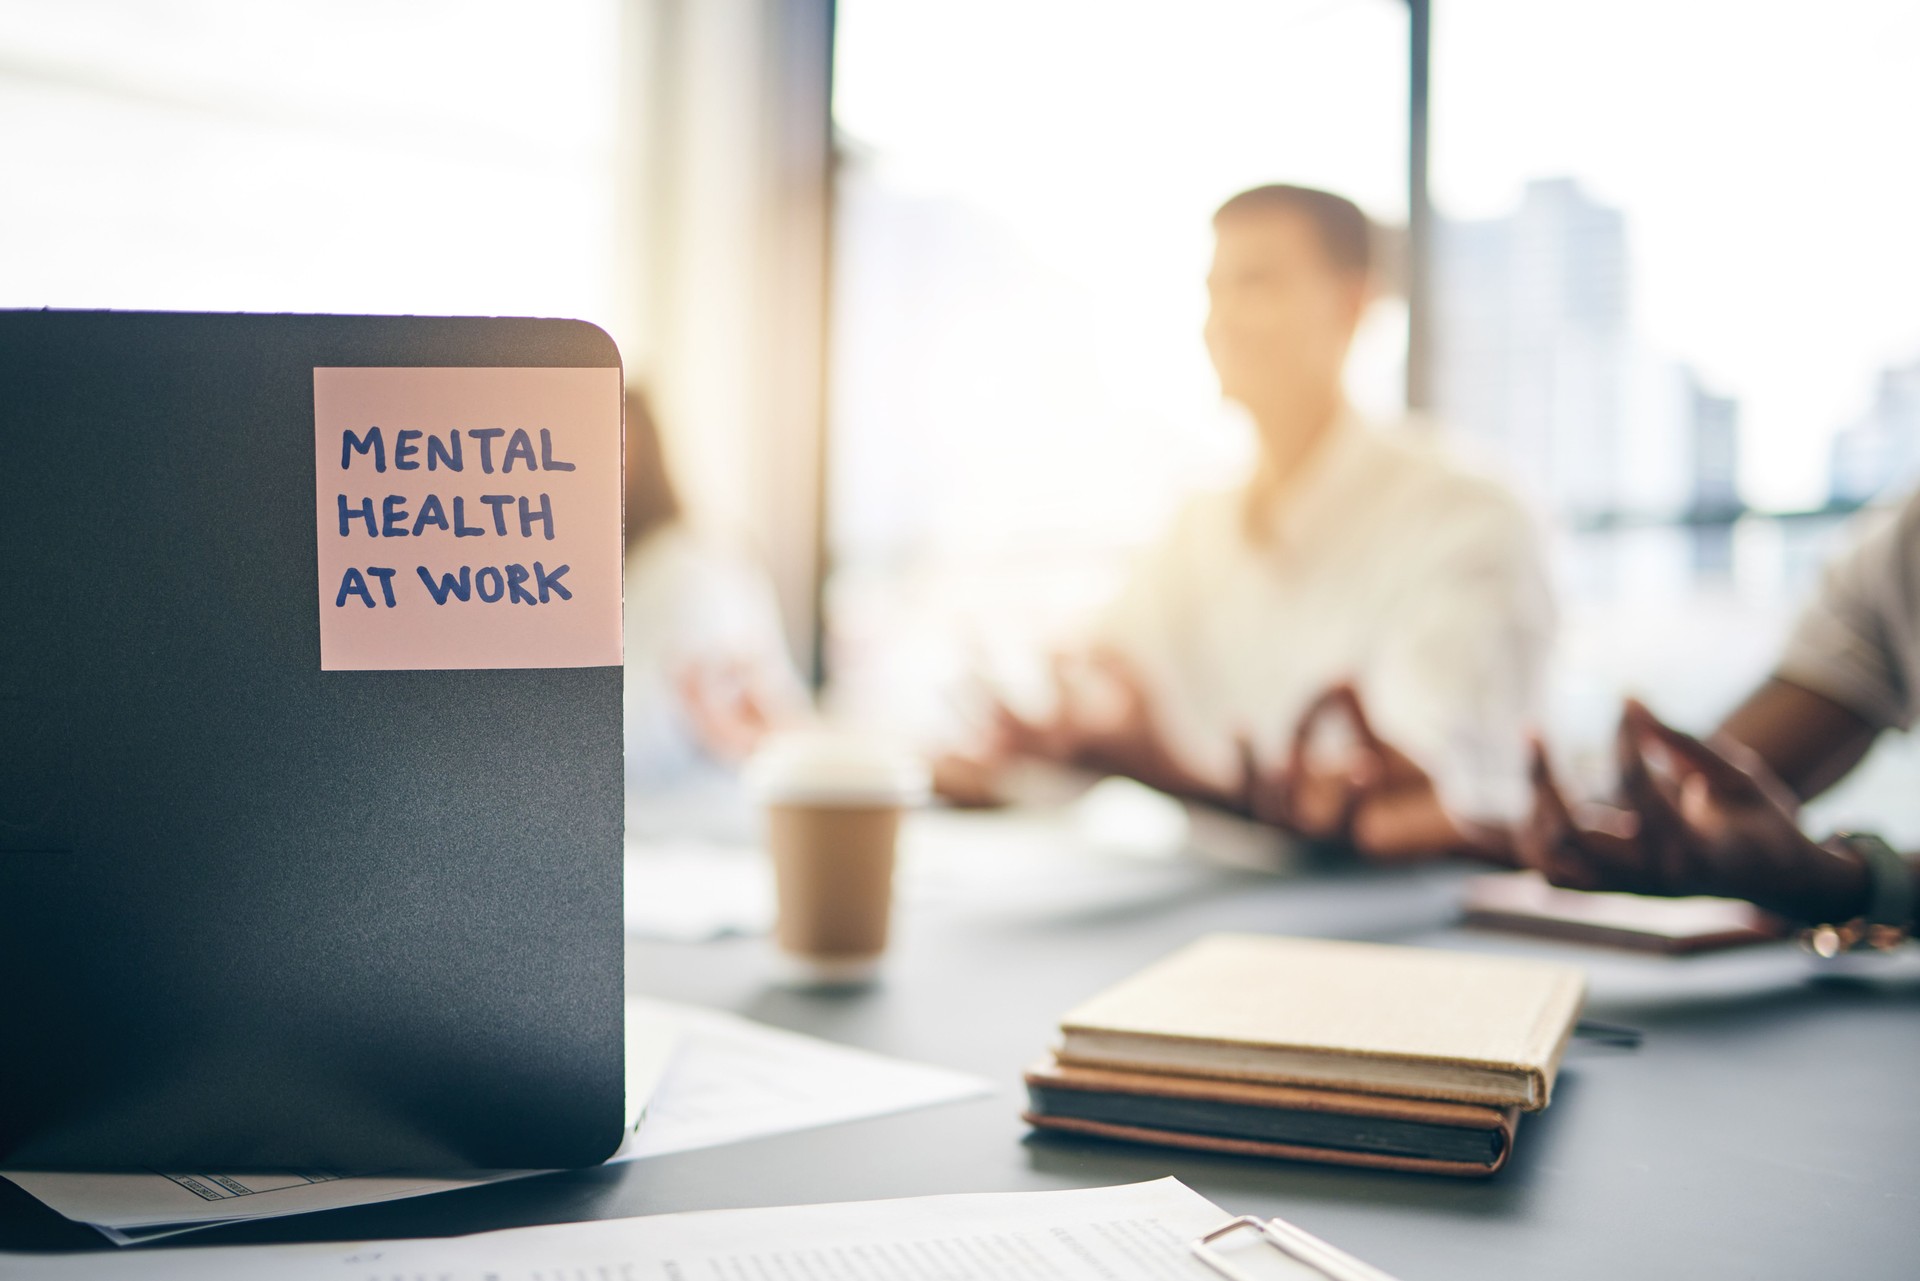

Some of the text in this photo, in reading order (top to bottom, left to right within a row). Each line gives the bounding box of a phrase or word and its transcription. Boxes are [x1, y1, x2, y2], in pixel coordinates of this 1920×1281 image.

[341, 426, 576, 474] MENTAL
[337, 493, 555, 540] HEALTH
[335, 561, 573, 608] AT WORK
